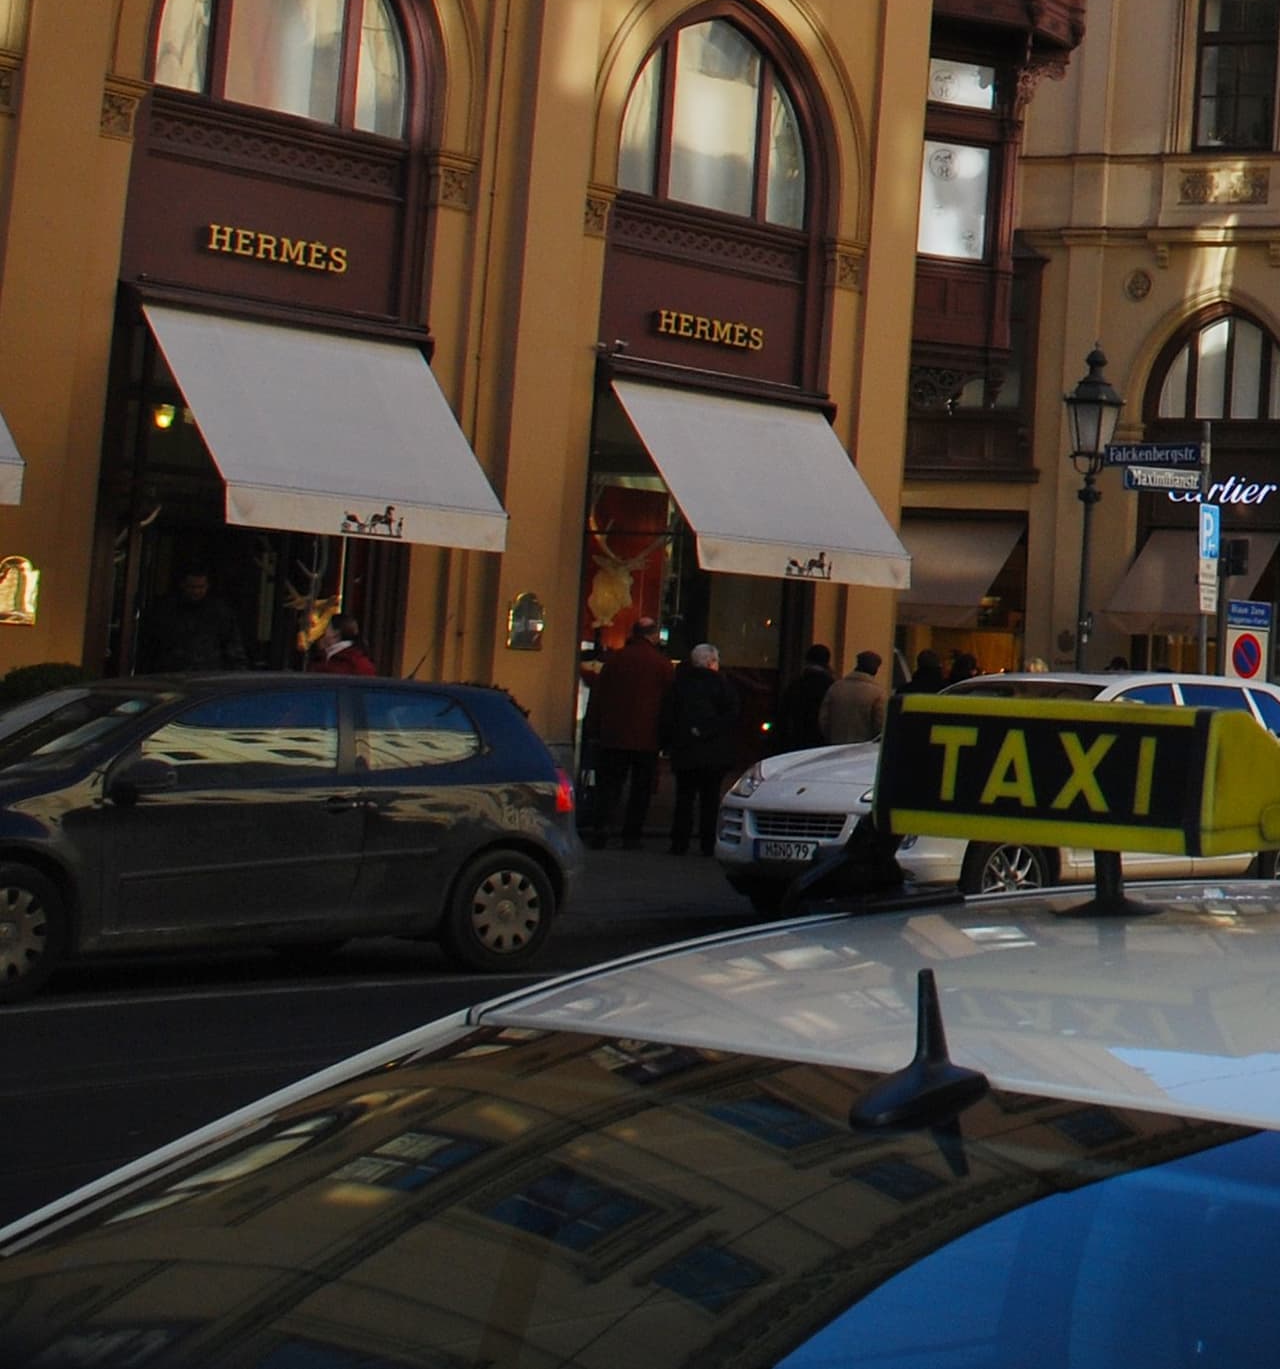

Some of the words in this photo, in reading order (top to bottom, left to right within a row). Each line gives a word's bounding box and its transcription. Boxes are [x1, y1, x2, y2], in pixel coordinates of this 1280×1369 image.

[207, 223, 349, 274] HERMÈS
[658, 309, 764, 351] HERMÈS
[1109, 446, 1197, 463] Falckenbergstr.
[928, 725, 1157, 816] TAXI
